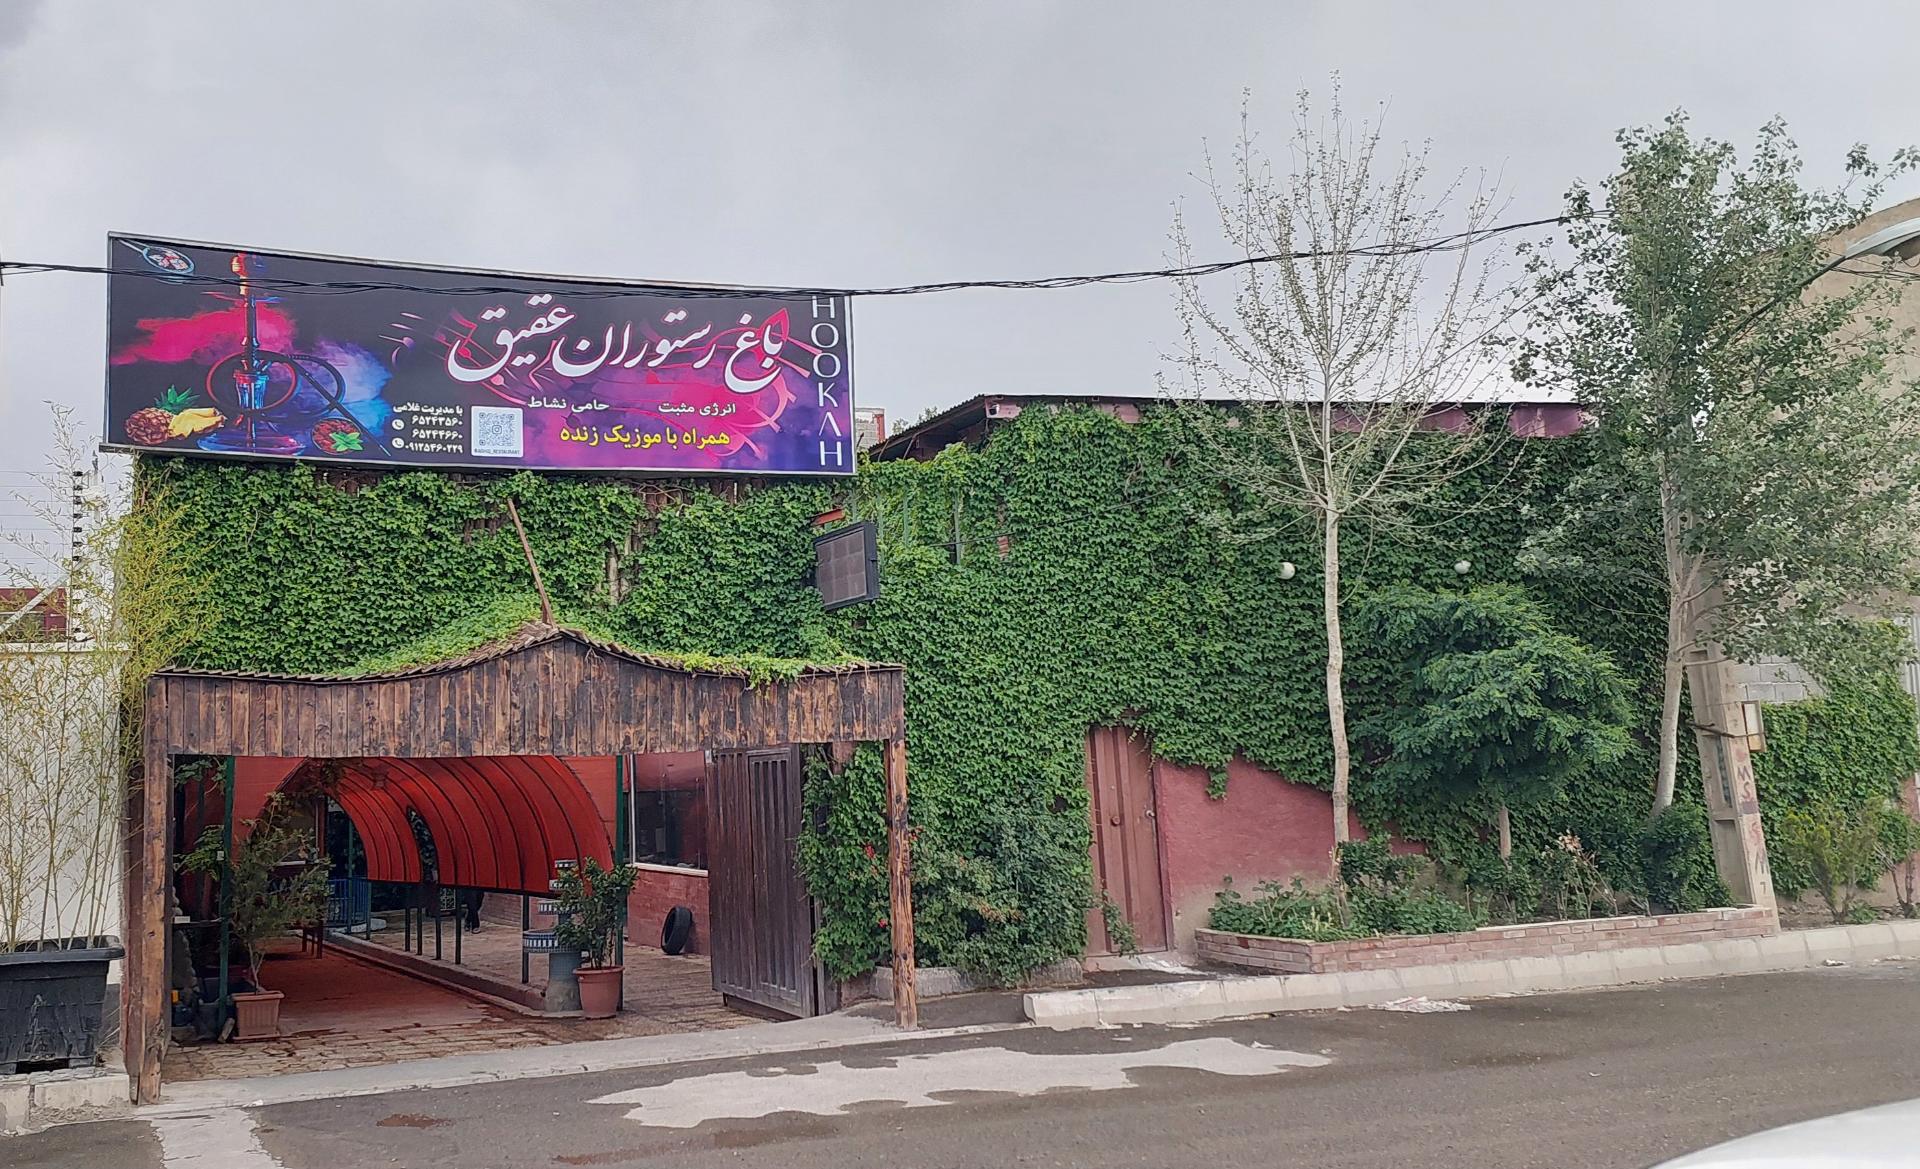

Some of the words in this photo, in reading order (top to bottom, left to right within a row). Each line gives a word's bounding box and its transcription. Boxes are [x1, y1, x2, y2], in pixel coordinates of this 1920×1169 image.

[447, 293, 575, 383] عقیق
[551, 310, 716, 378] رستوران
[724, 313, 784, 394] باغ
[810, 295, 843, 467] HOOKAH
[392, 402, 420, 413] غلامی
[421, 404, 454, 416] مدیریت
[455, 405, 463, 417] با
[527, 396, 567, 409] نشاط
[571, 399, 610, 414] حامی
[658, 401, 695, 414] مثبت
[699, 402, 736, 416] انرژی
[559, 426, 600, 446] زنده
[603, 424, 662, 448] موزیک
[665, 426, 678, 450] با
[682, 427, 731, 450] همراه
